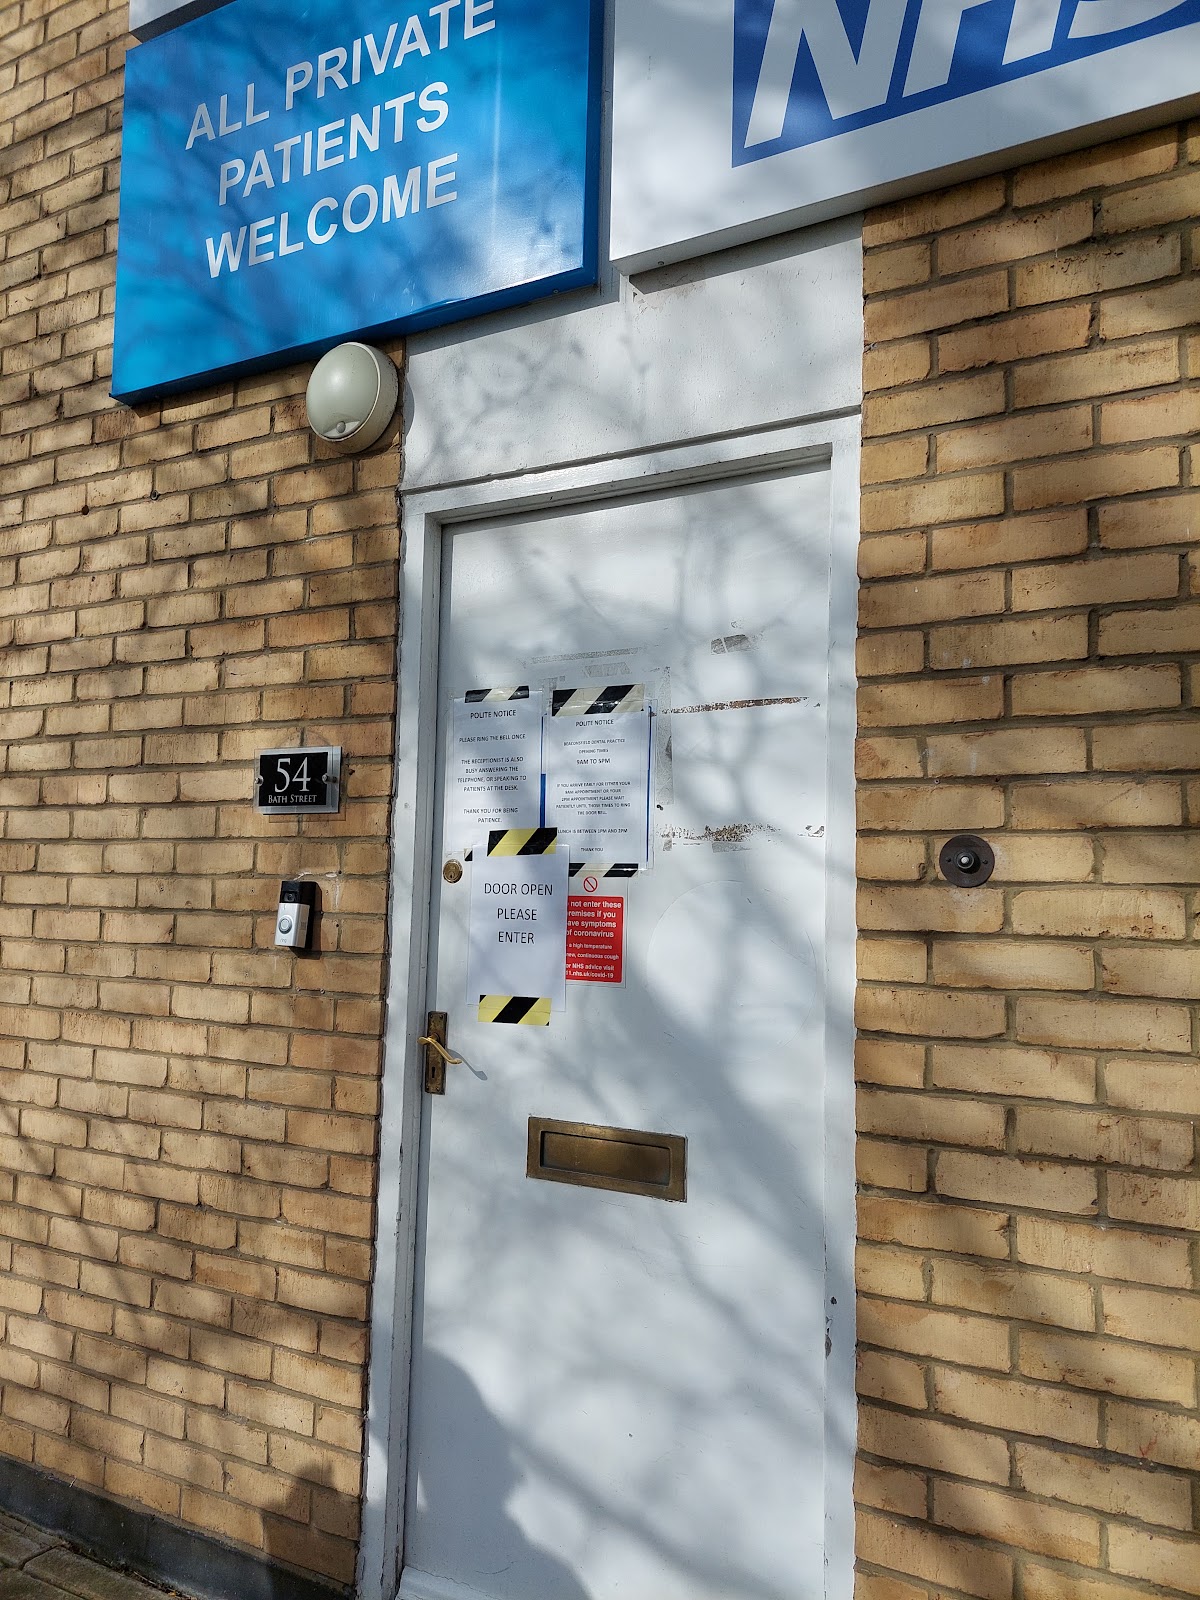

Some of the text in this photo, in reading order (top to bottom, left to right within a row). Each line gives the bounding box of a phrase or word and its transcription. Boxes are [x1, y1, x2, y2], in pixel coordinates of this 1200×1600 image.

[185, 0, 496, 150] ALL PRIVATE
[218, 81, 449, 206] PATIENTS
[205, 153, 458, 279] WELCOME
[274, 756, 312, 793] 54
[268, 794, 317, 804] BATH STREET
[484, 883, 553, 895] DOOR OPEN
[497, 908, 537, 921] PLEASE
[603, 911, 616, 919] you
[581, 921, 616, 929] symptoms
[498, 931, 534, 944] ENTER
[574, 930, 614, 938] coronavirus
